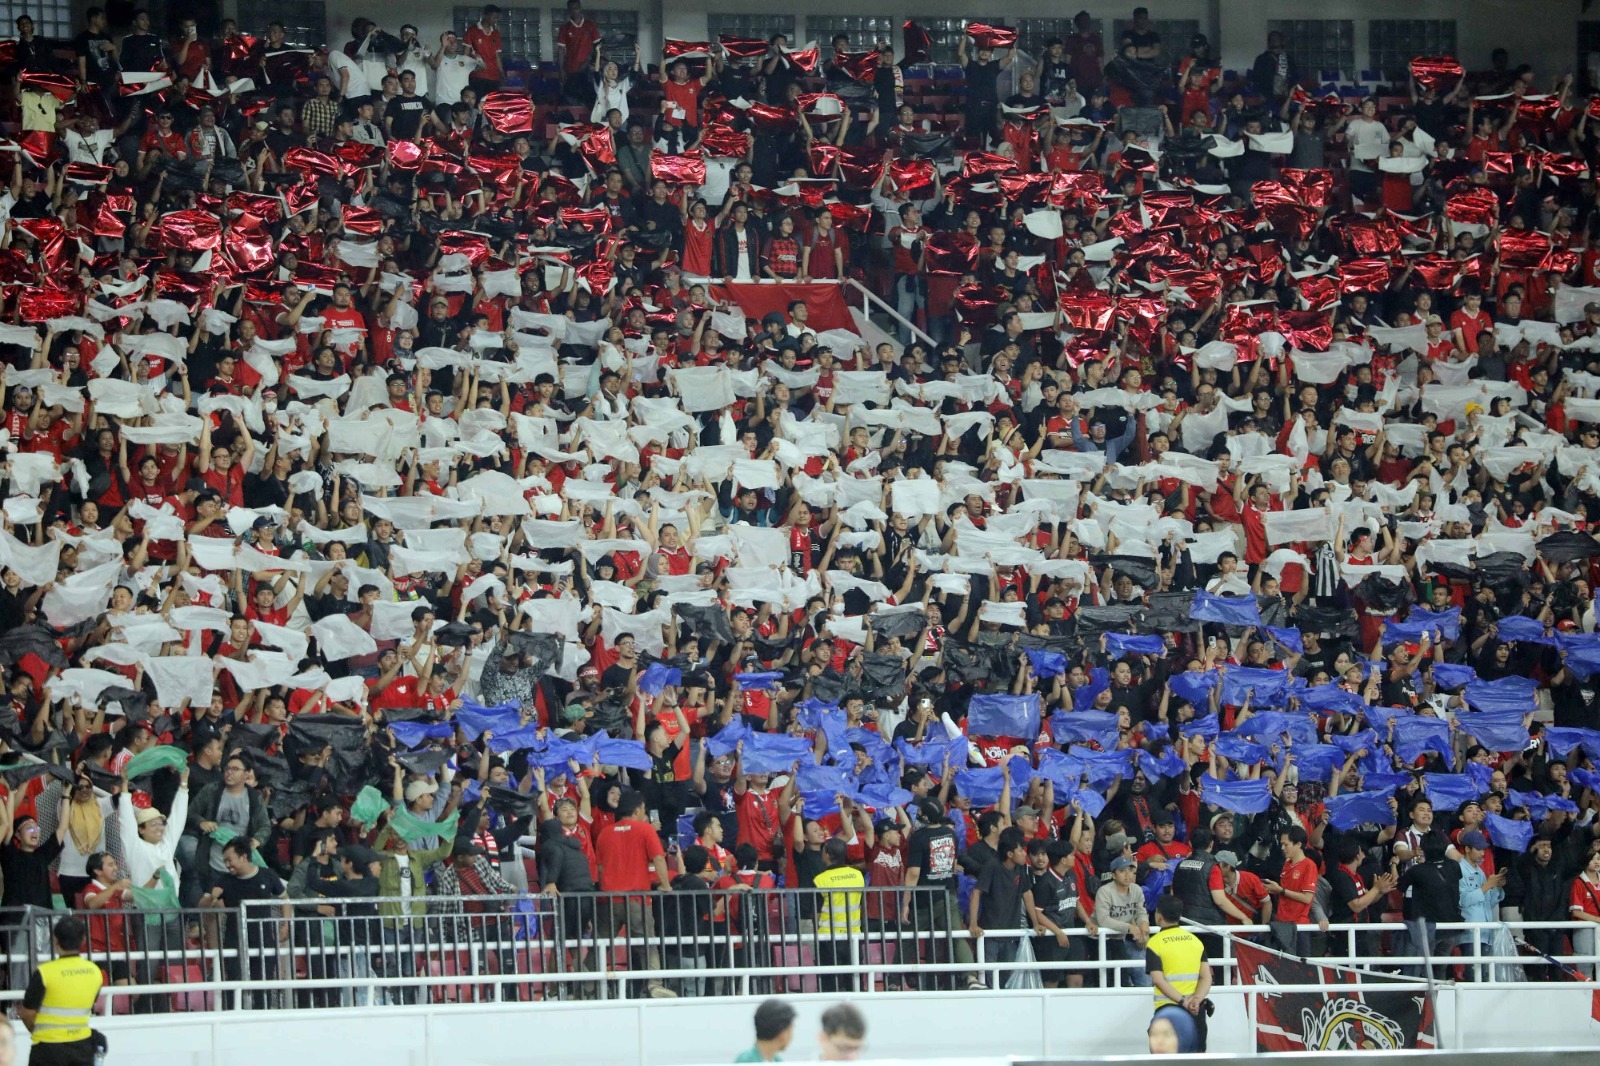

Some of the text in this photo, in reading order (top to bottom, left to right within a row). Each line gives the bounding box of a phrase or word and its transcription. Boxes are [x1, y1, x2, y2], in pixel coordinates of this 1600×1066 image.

[984, 747, 1008, 759] NORD
[830, 873, 857, 882] STEWARD
[1163, 934, 1193, 944] STEWARD
[61, 967, 95, 977] STEWARD
